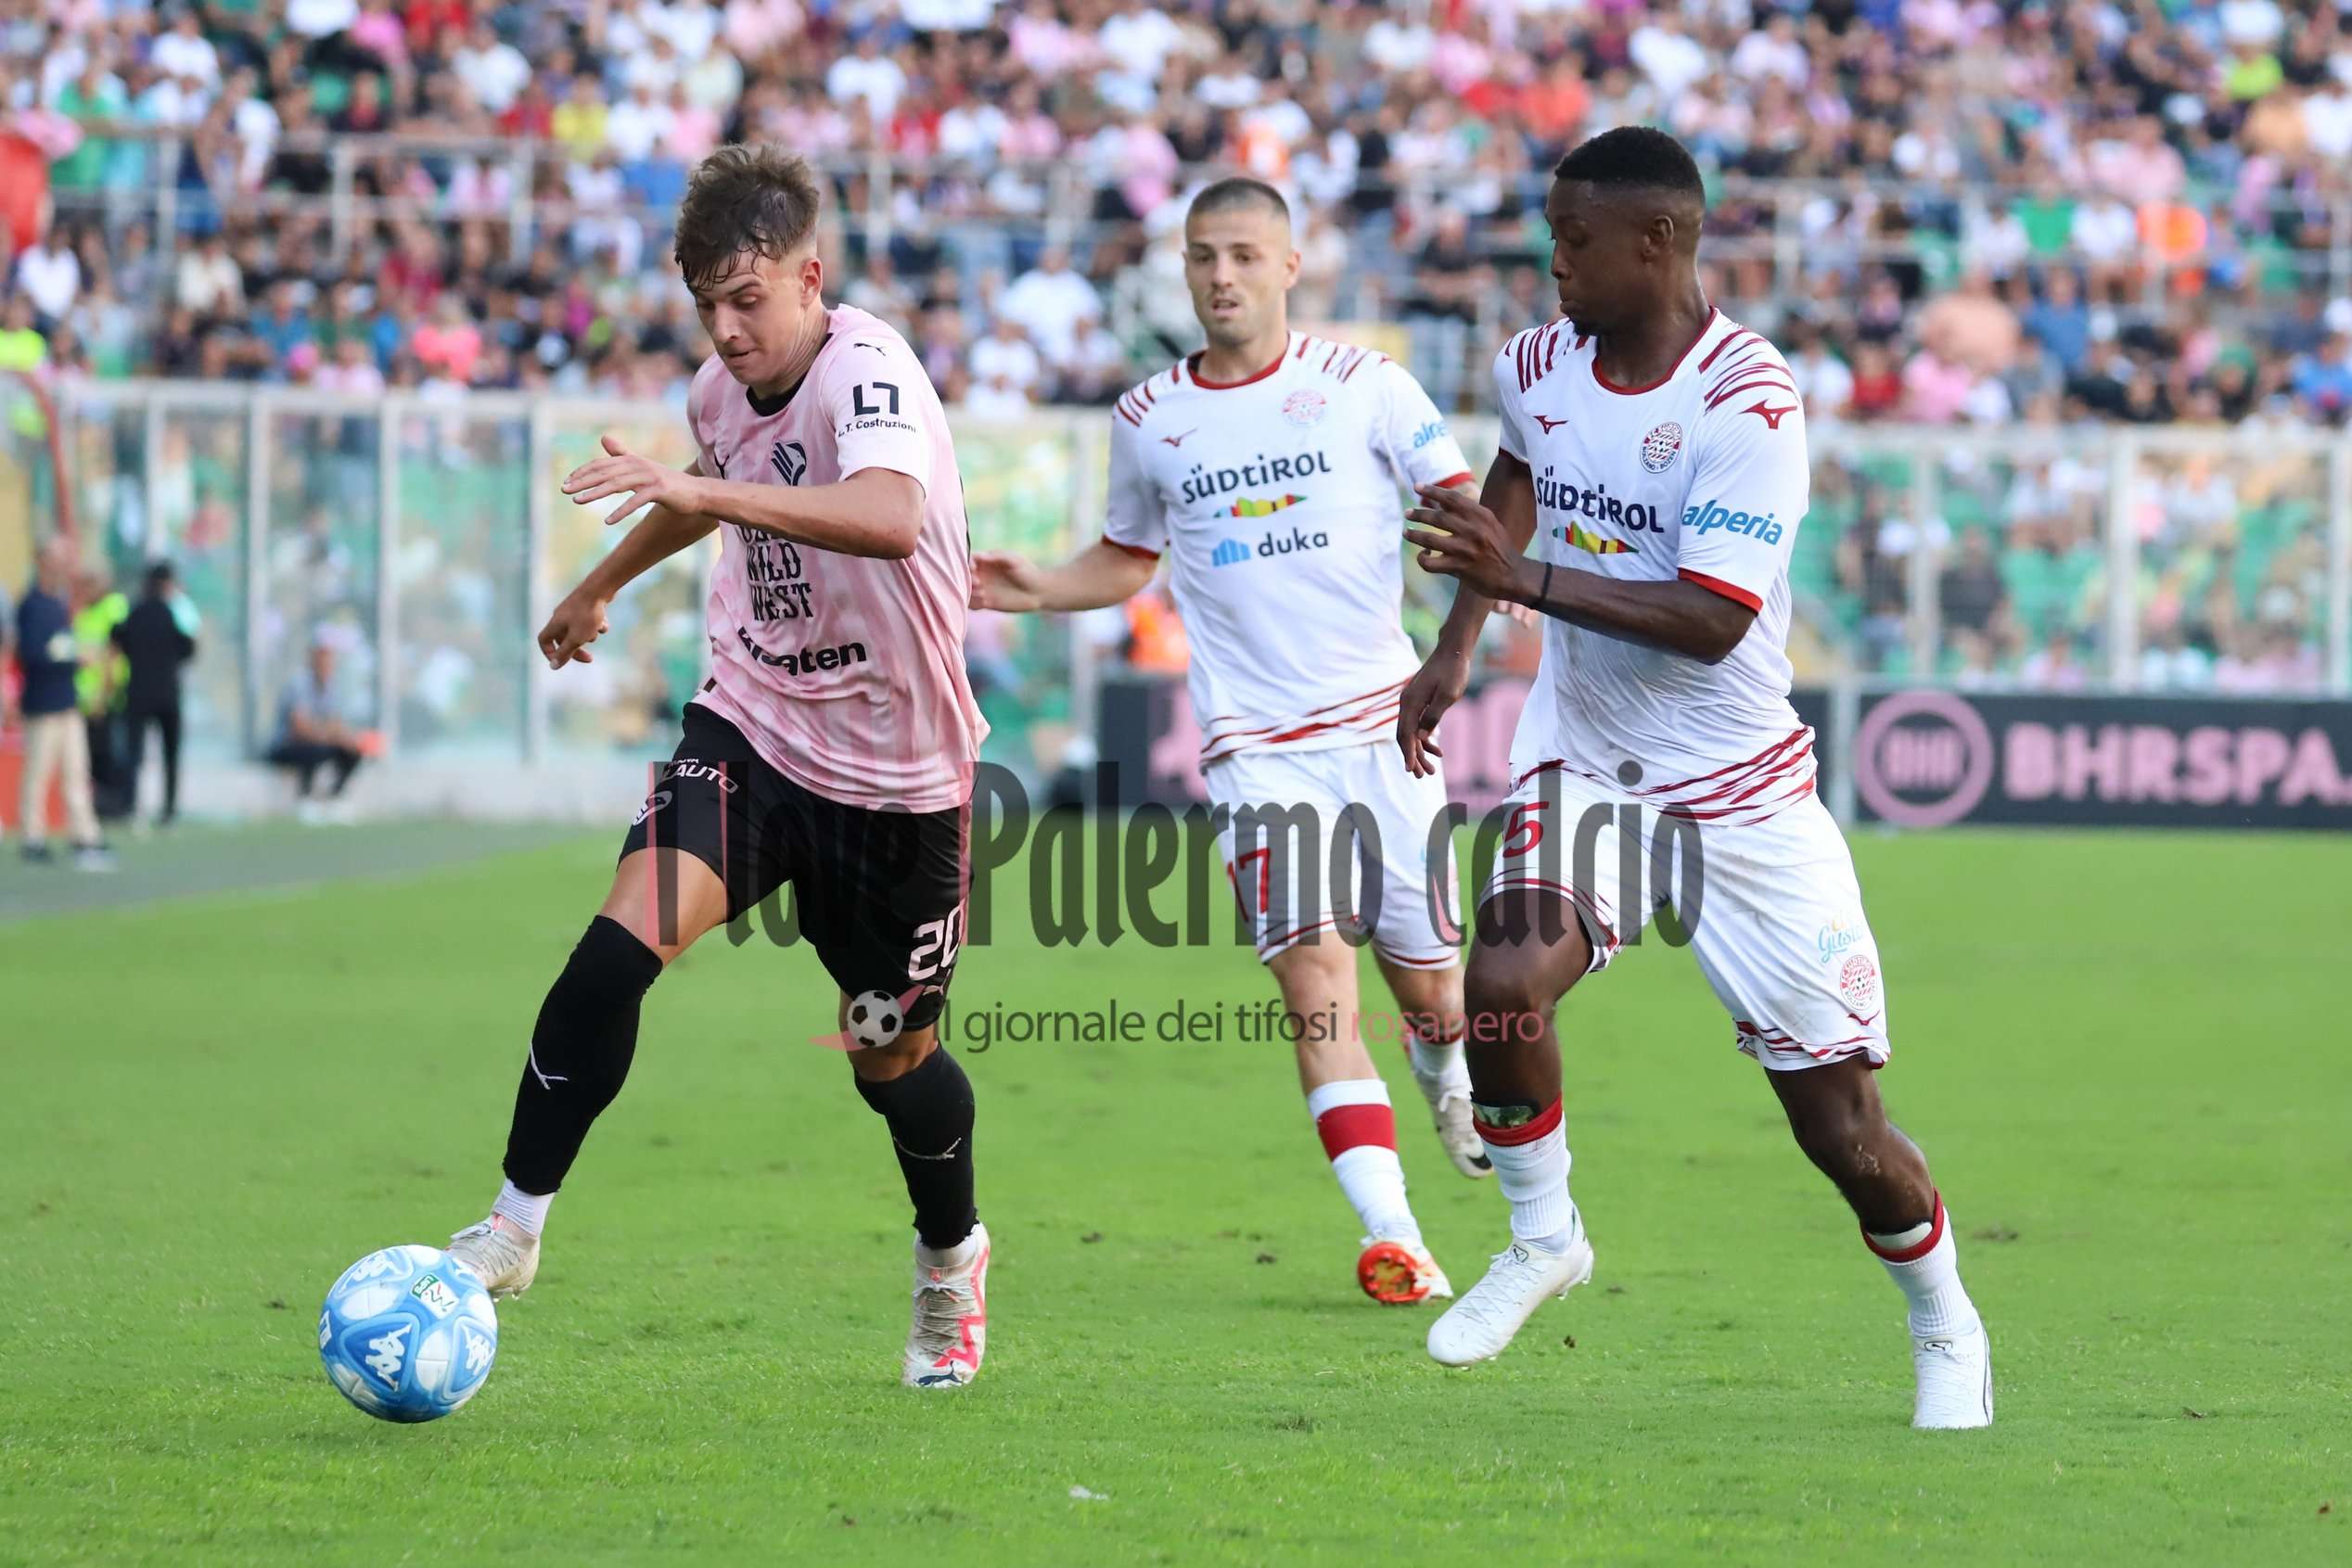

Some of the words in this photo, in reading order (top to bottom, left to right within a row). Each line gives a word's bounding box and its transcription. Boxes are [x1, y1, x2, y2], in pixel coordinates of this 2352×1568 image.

[1258, 528, 1329, 558] duka
[1681, 500, 1783, 545] alperia
[1502, 800, 1550, 859] 5
[1227, 847, 1271, 923] 17
[908, 899, 965, 981] 20
